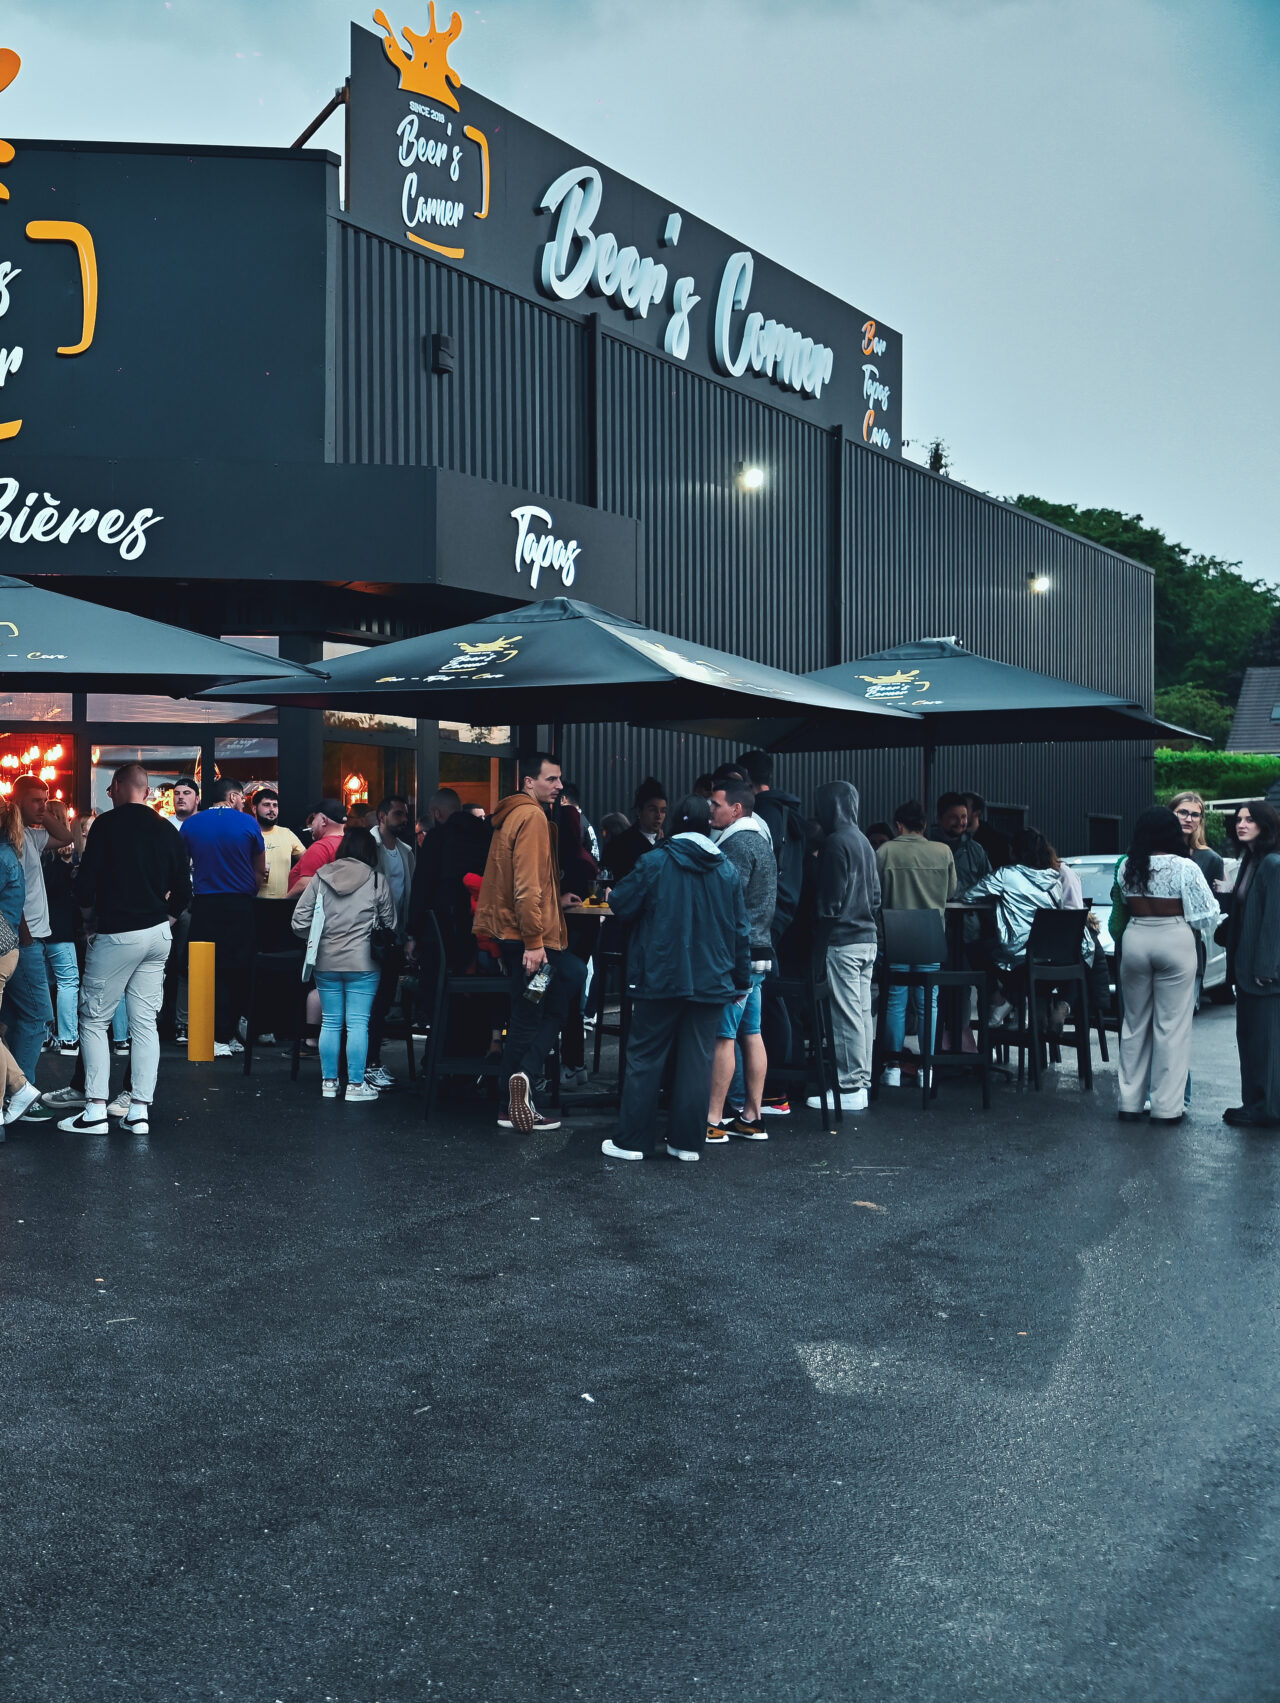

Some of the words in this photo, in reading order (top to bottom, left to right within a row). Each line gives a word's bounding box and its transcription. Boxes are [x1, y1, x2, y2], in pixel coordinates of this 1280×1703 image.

[409, 101, 431, 118] SINCE
[431, 109, 446, 124] 2018
[396, 114, 464, 182] Beer's
[401, 172, 465, 228] Corner
[540, 165, 701, 360] Beer's
[714, 252, 833, 399] Corner
[861, 320, 887, 357] Bar
[861, 364, 891, 411] Tapas
[863, 409, 891, 450] Cave
[510, 505, 582, 590] Tapas
[26, 652, 68, 660] Cave
